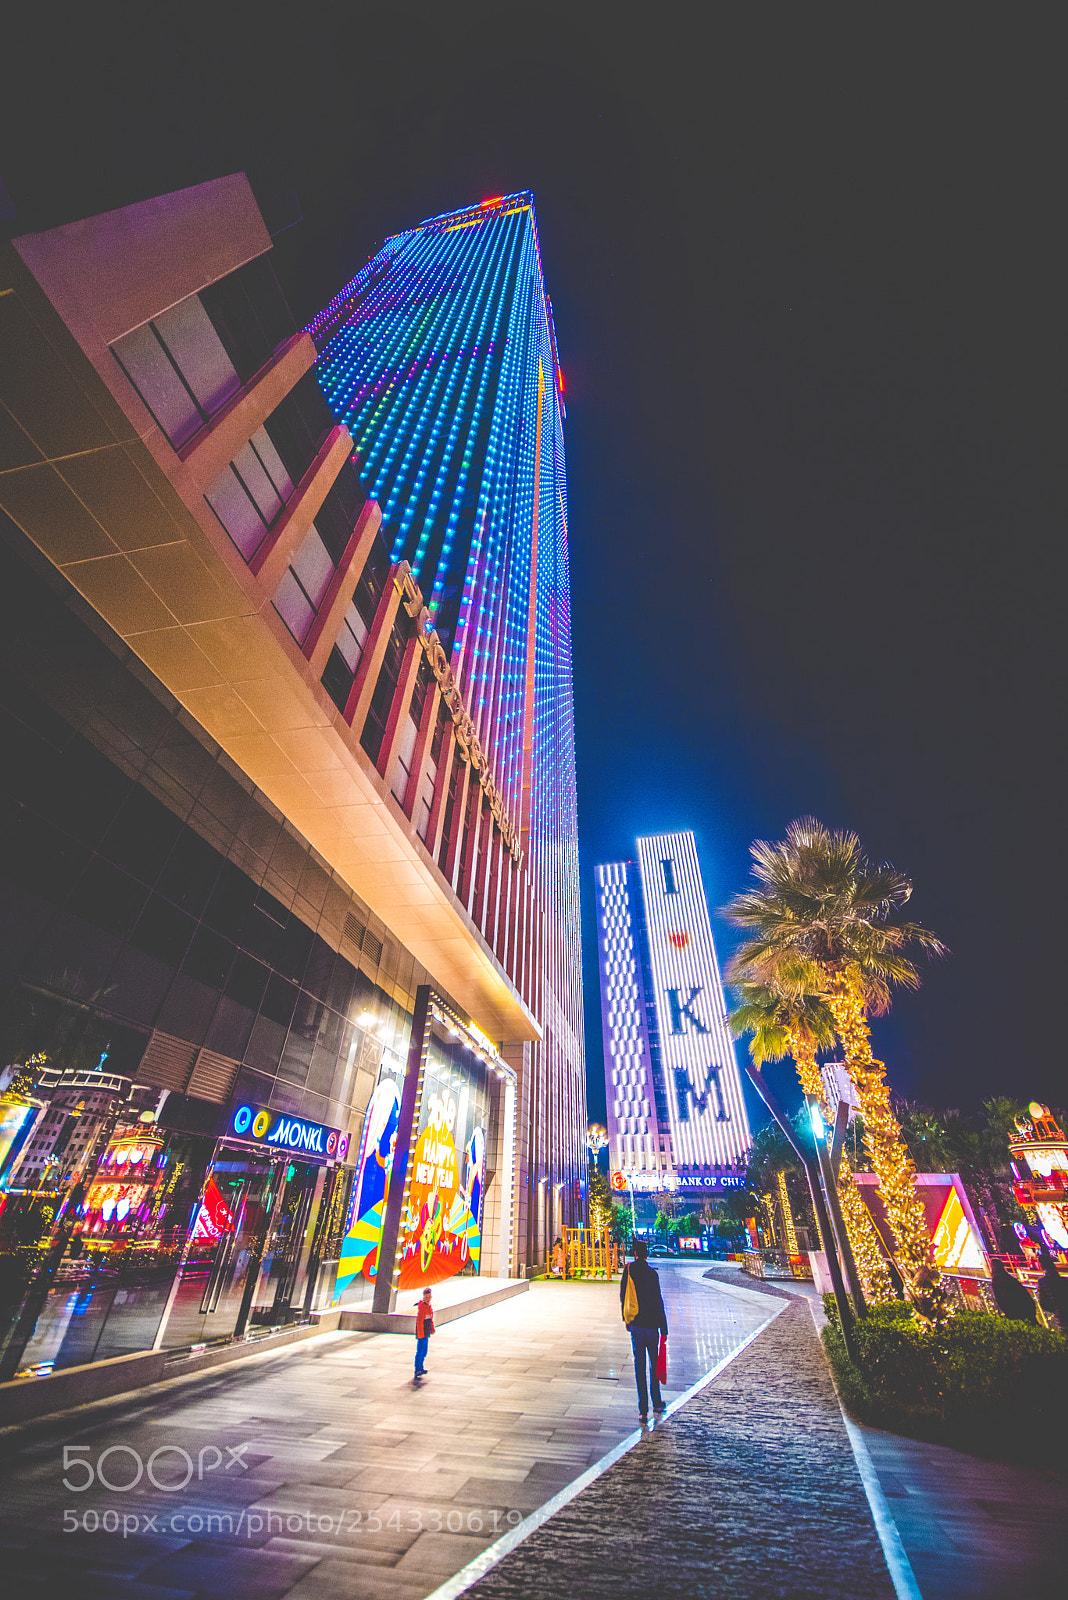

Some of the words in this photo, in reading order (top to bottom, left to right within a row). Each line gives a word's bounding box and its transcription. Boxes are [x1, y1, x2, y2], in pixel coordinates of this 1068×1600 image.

[268, 1119, 323, 1153] MONKI
[423, 1138, 452, 1167] HAPPY
[416, 1162, 435, 1185] NEW
[437, 1168, 453, 1188] YEAR
[676, 1177, 702, 1186] BANK
[704, 1177, 717, 1187] OF
